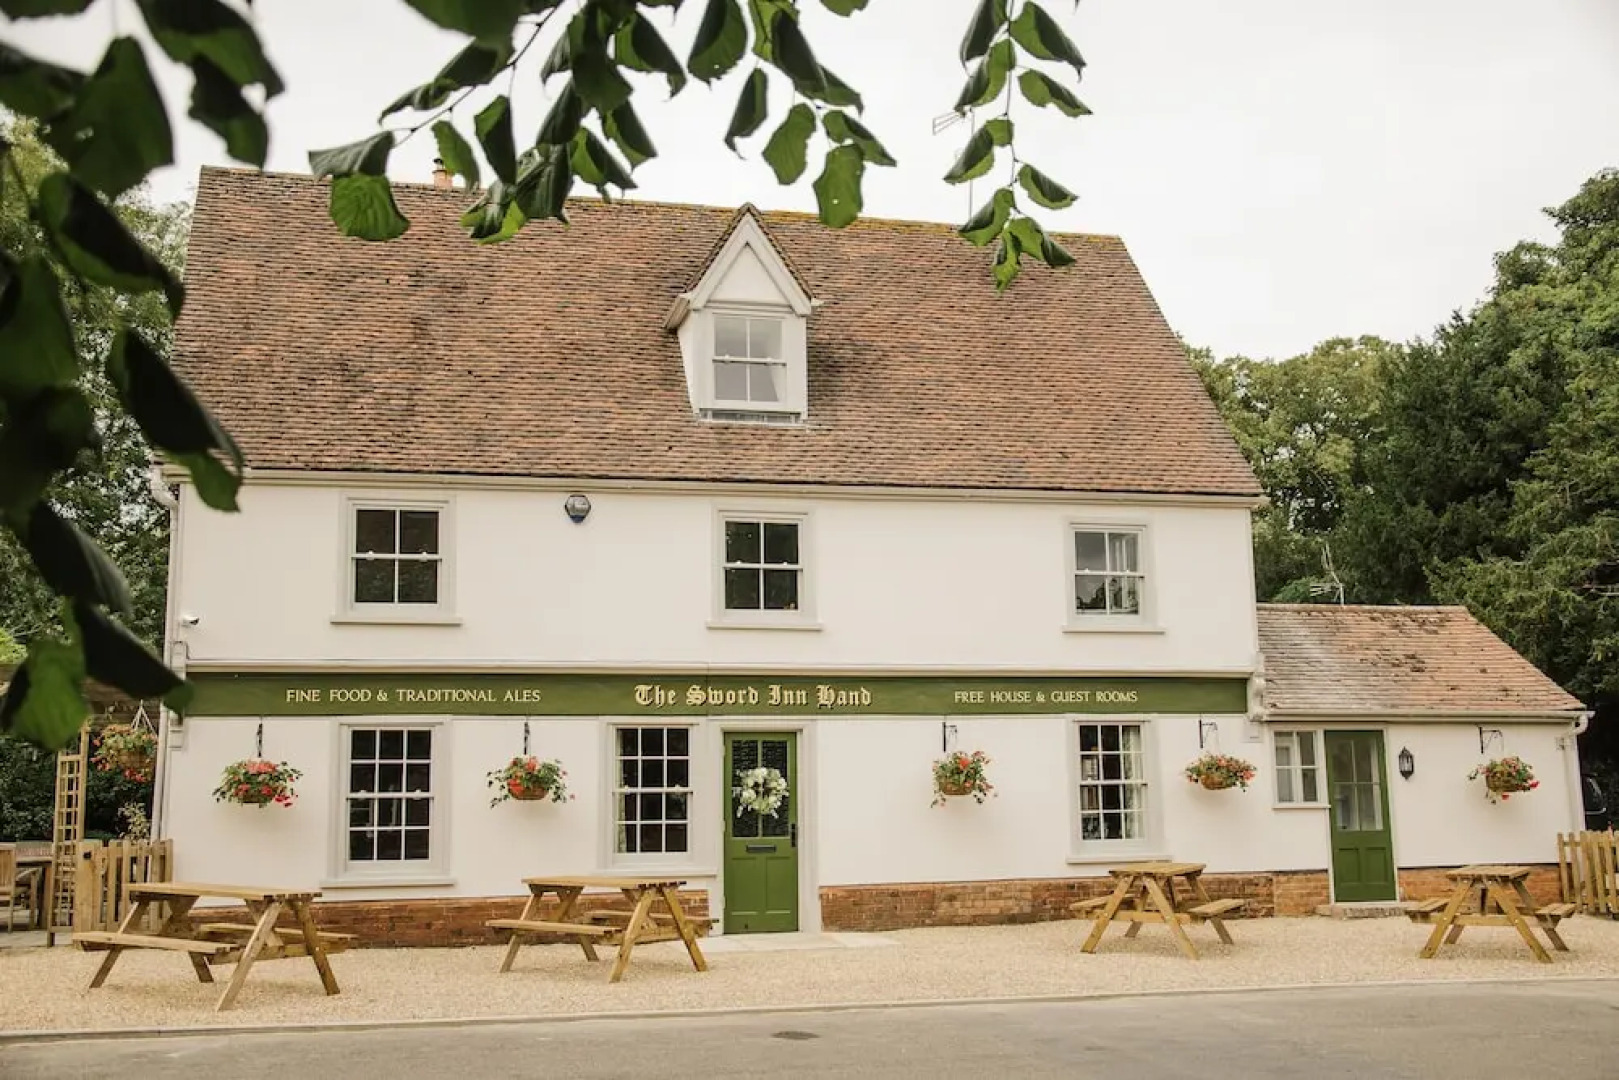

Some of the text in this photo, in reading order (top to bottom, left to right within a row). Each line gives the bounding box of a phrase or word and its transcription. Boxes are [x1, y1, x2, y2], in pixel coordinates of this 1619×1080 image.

[285, 689, 541, 703] FINE FOOD & TRADITIONAL ALES
[634, 684, 872, 709] The Sword Inn Hand
[954, 690, 1138, 704] FREE HOUSE & GUEST ROOMS
